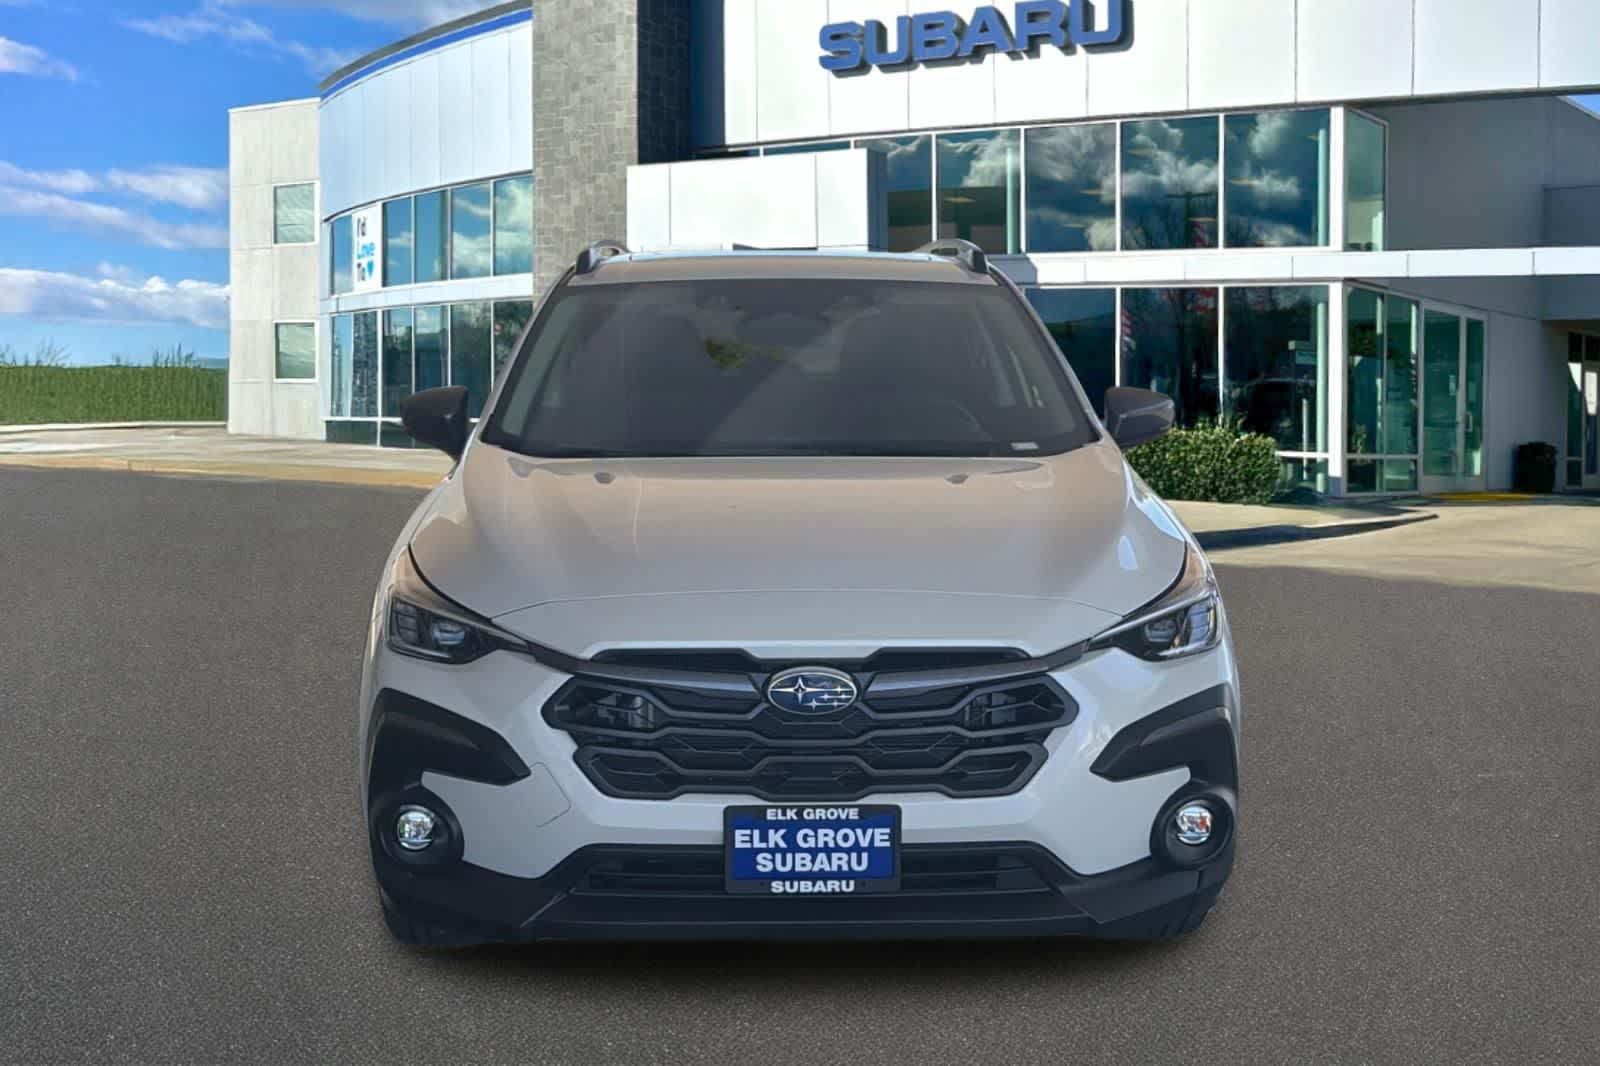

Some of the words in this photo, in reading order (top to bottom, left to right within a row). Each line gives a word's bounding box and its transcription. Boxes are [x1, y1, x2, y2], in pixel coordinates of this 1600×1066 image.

[819, 0, 1132, 77] SUBARU
[766, 808, 798, 820] ELK
[803, 808, 860, 820] GROVE
[734, 829, 788, 848] ELK
[796, 828, 891, 848] GROVE
[756, 852, 869, 872] SUBARU
[771, 880, 855, 893] SUBARU
